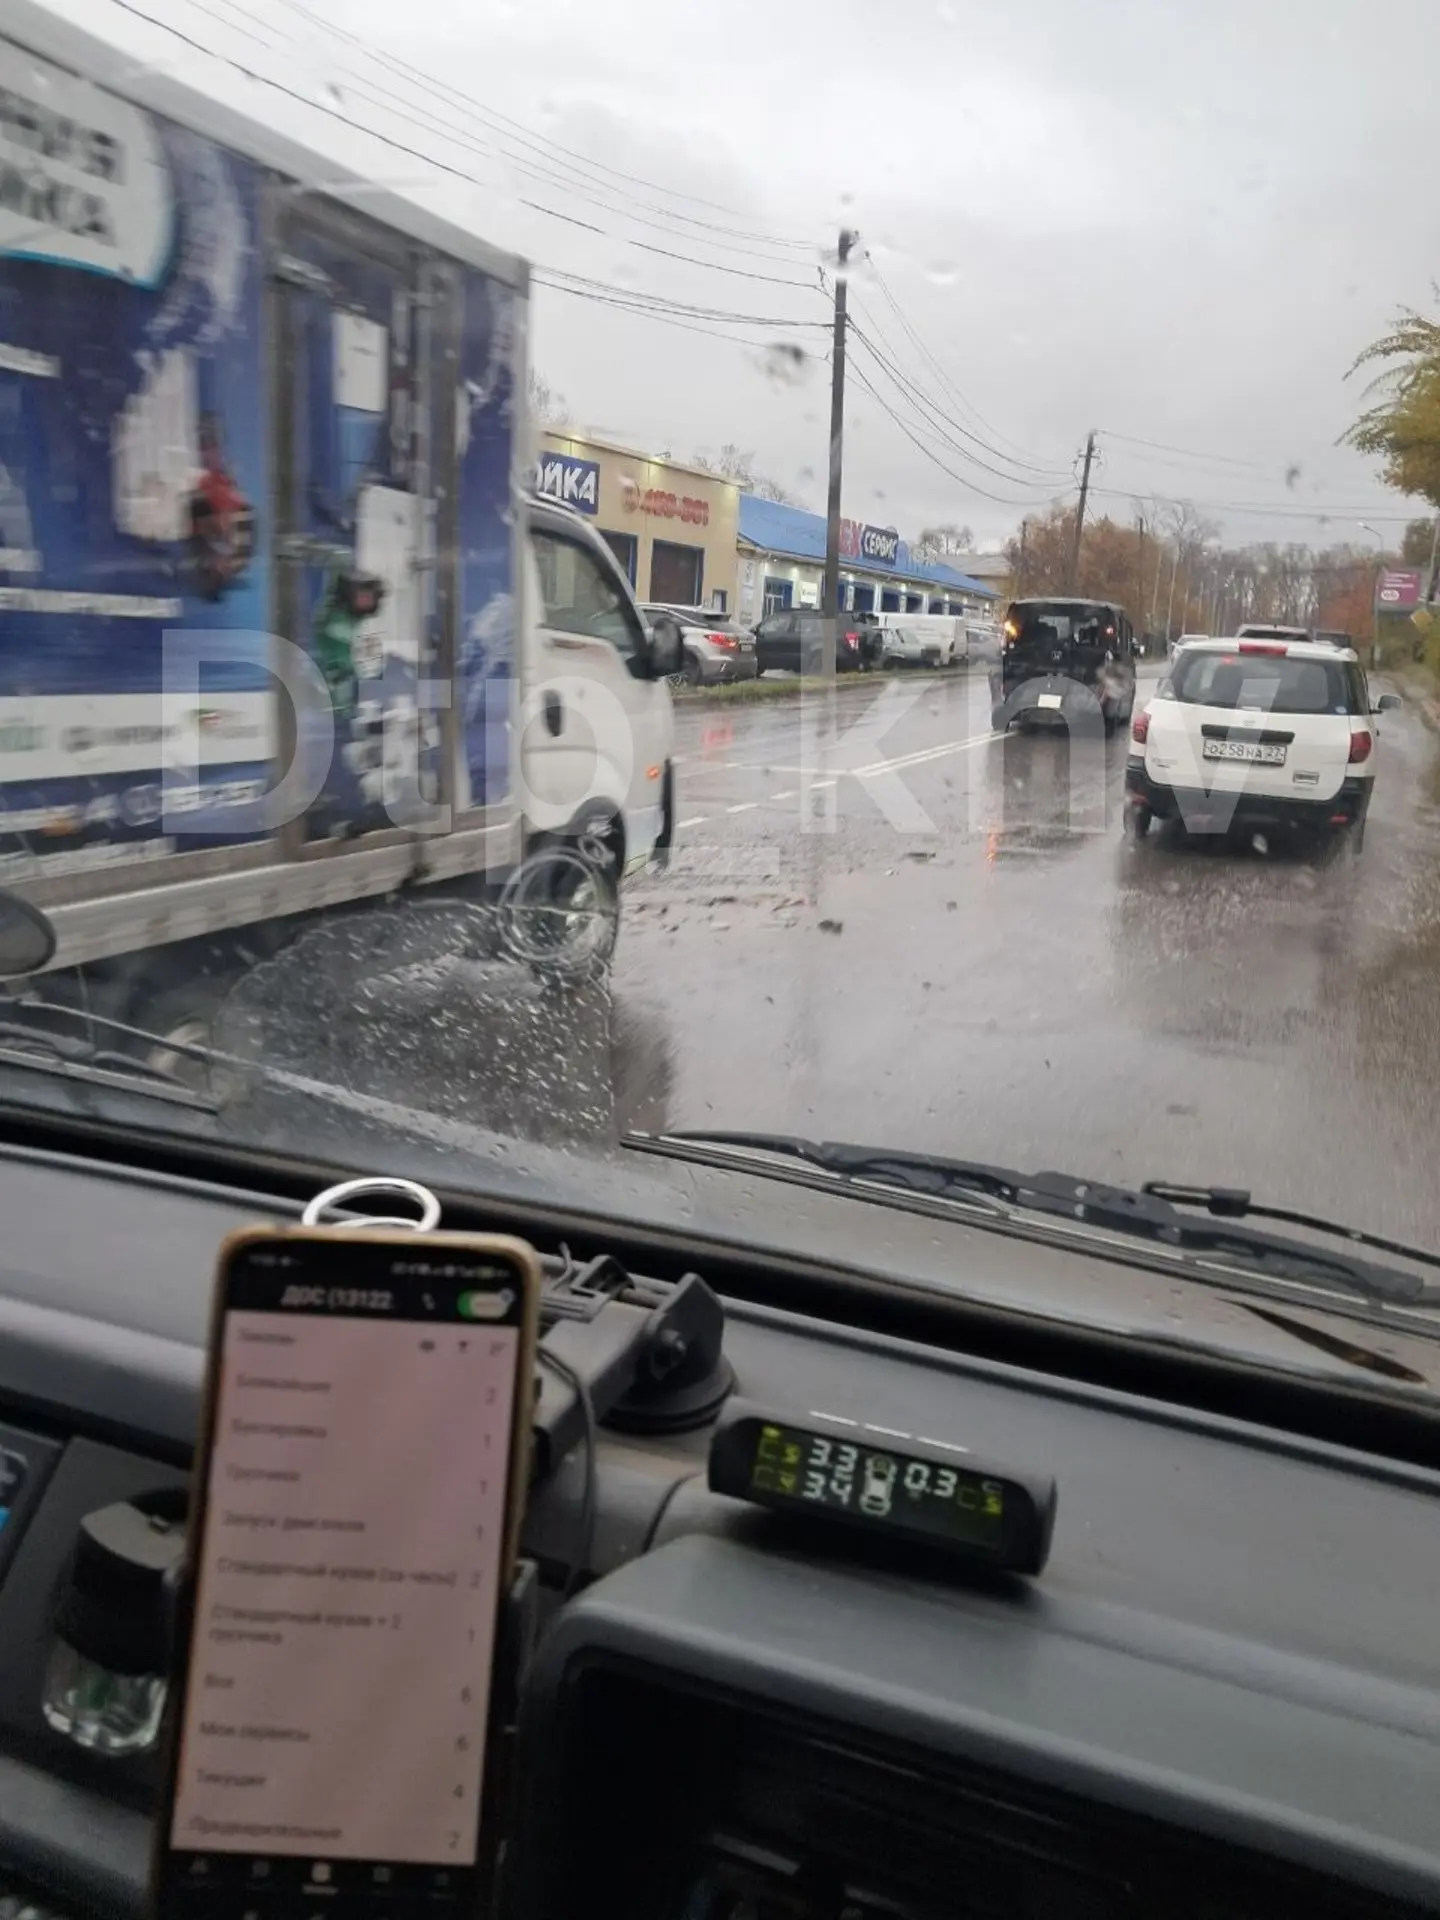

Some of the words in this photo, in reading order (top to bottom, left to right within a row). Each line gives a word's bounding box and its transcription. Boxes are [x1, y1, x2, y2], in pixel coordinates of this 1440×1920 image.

[864, 529, 897, 562] СЕРВИС
[808, 1438, 858, 1473] 3.3
[904, 1462, 958, 1498] 0.3
